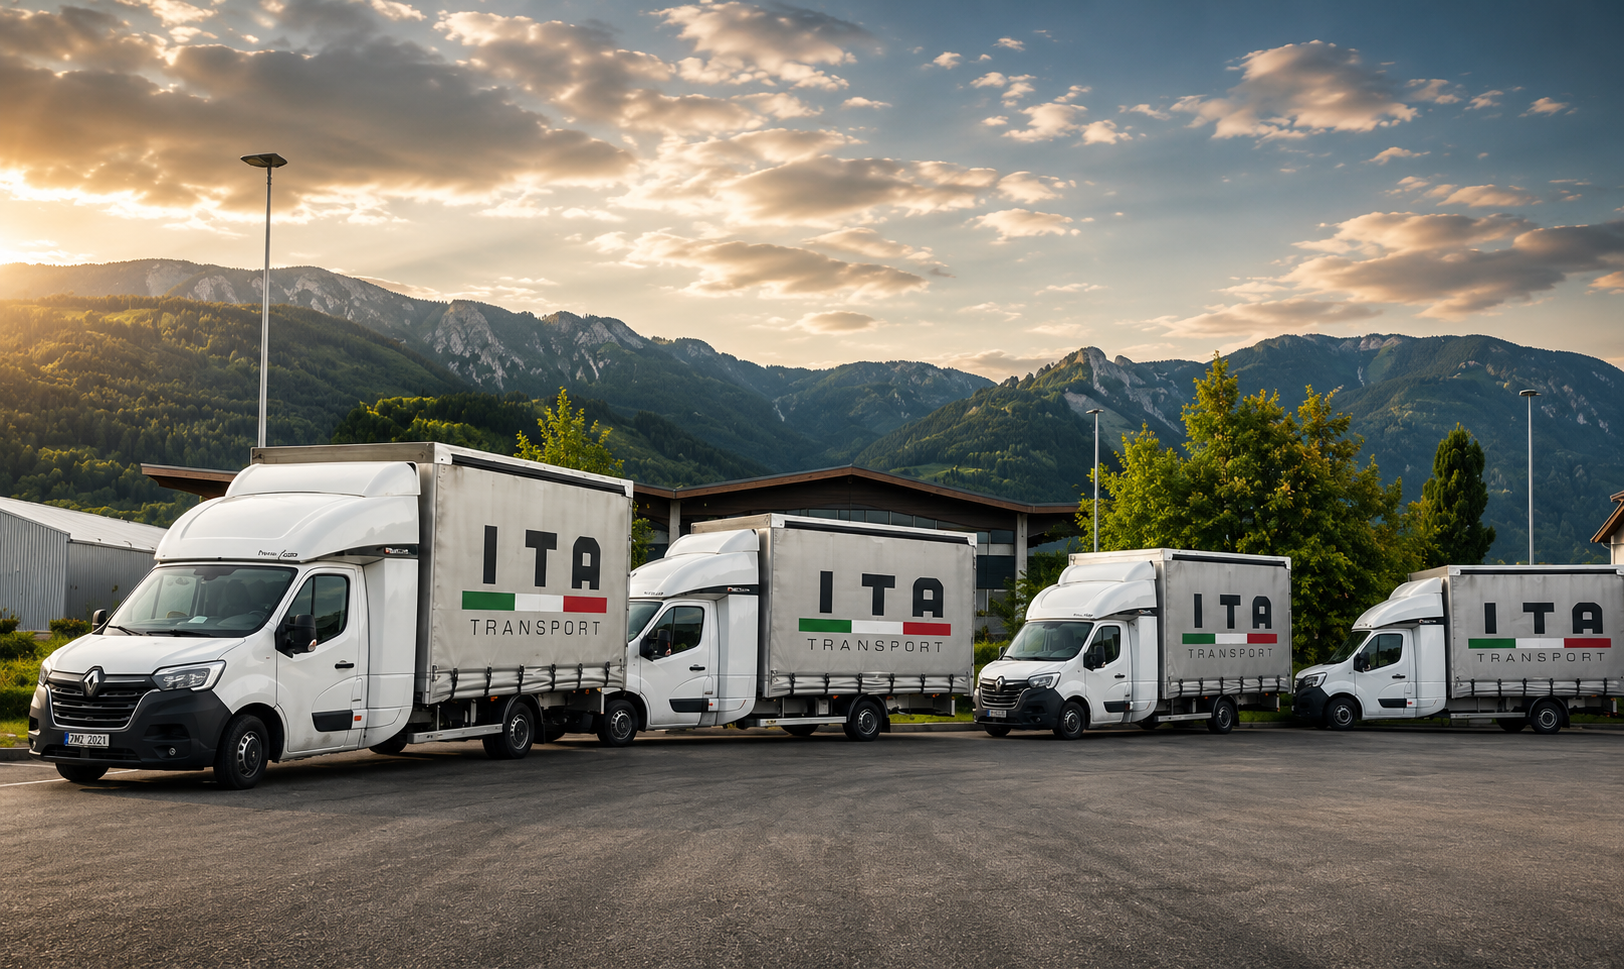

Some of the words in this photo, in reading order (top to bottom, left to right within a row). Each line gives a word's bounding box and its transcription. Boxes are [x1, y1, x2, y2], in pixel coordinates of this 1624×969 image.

[482, 524, 601, 591] ITA
[819, 570, 944, 619] ITA
[1193, 593, 1273, 630] ITA
[1483, 602, 1604, 635] ITA
[470, 618, 602, 636] TRANSPORT
[806, 638, 944, 653] TRANSPORT
[1187, 647, 1274, 660] TRANSPORT
[1476, 652, 1606, 663] TRANSPORT
[87, 735, 106, 745] 2021
